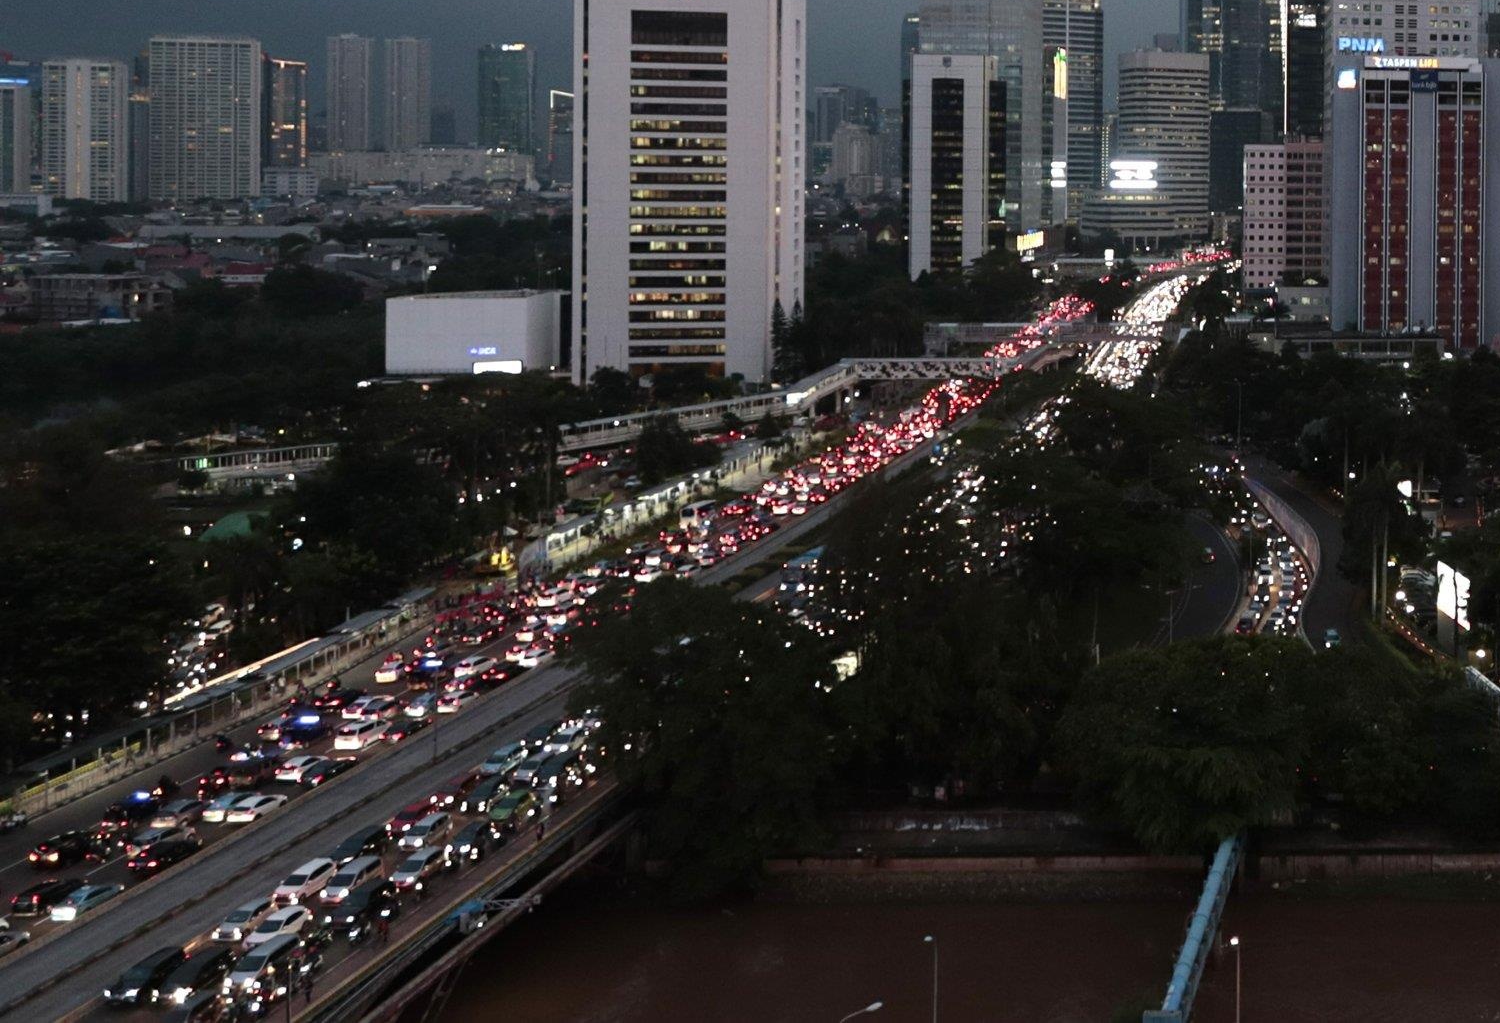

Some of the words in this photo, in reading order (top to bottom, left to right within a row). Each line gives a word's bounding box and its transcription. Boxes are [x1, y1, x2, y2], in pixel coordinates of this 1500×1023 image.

[1338, 37, 1385, 52] PNM
[1382, 58, 1417, 67] TASPEN
[1419, 58, 1439, 68] LIFE
